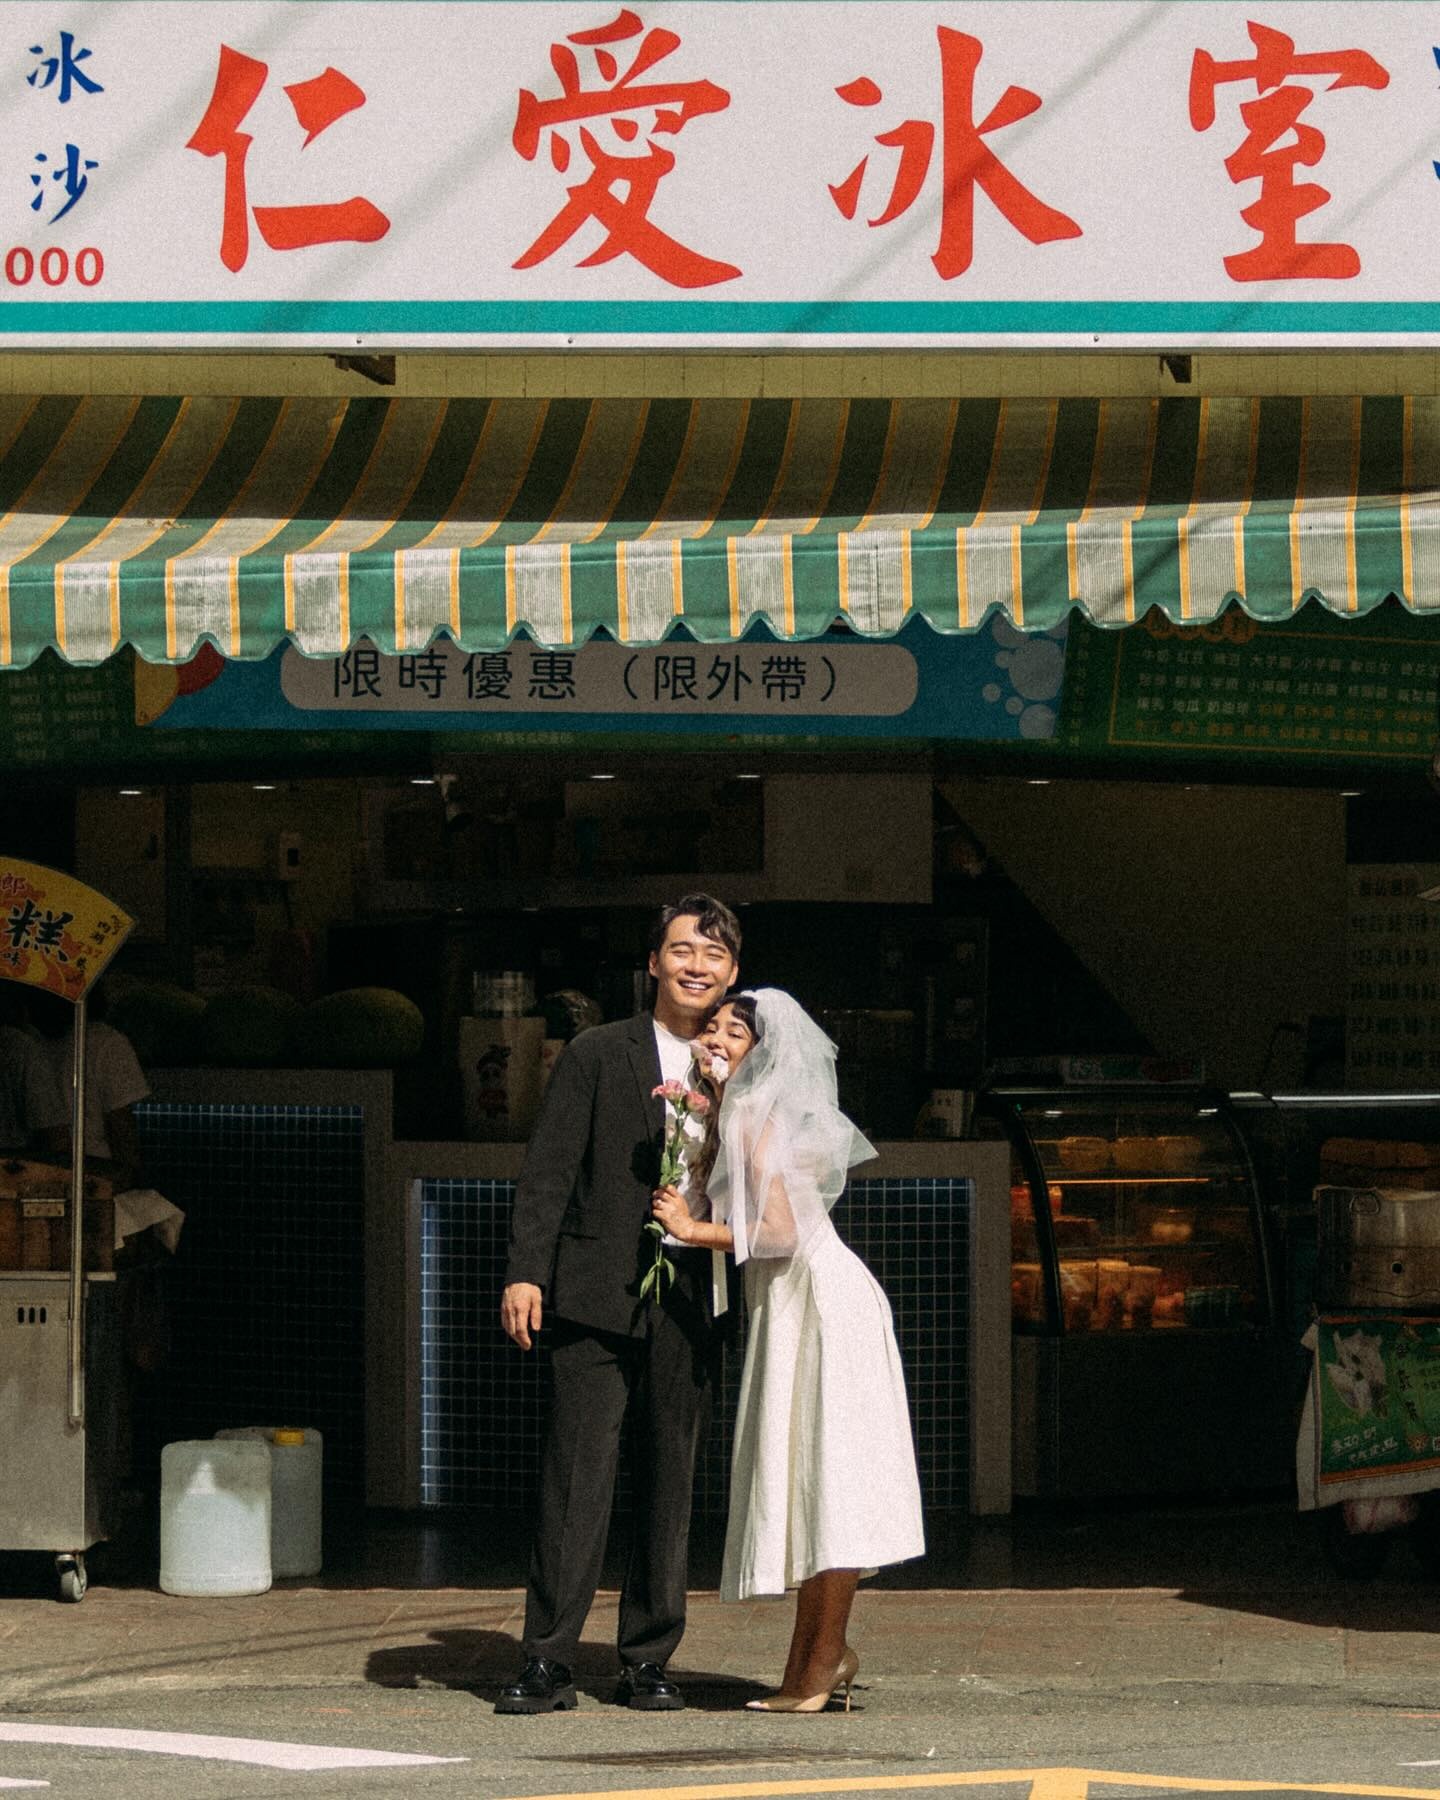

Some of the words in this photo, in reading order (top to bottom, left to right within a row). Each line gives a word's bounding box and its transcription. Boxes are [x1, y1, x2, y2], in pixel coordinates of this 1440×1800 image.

[27, 31, 104, 225] 冰沙
[186, 9, 1390, 288] 仁愛冰室
